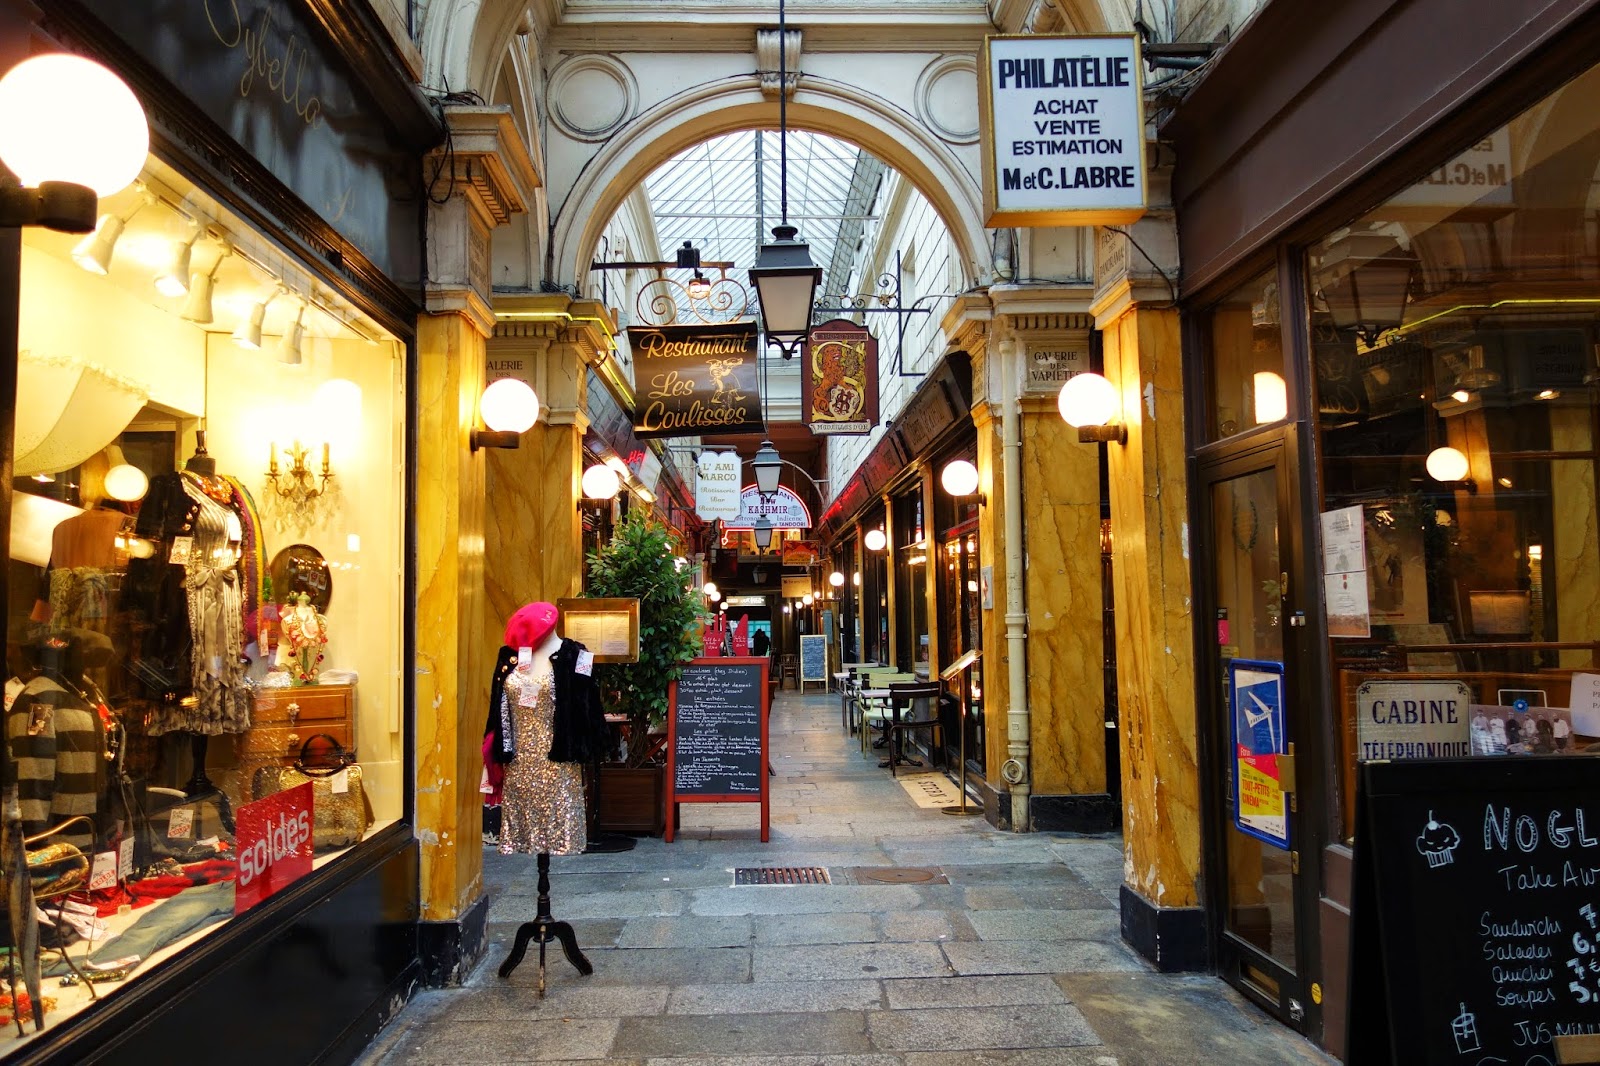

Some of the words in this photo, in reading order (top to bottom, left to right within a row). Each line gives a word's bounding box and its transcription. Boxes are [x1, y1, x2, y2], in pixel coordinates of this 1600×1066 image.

[1033, 99, 1099, 115] ACHAT
[1034, 120, 1100, 135] VENTE
[1012, 139, 1123, 155] ESTIMATION
[640, 332, 749, 358] Restaurant
[487, 361, 523, 370] ALERIE
[648, 371, 695, 399] Les
[643, 400, 747, 431] Coulisses
[715, 463, 735, 471] AMI
[701, 473, 737, 481] MARCO
[742, 489, 795, 502] RESANT
[748, 505, 788, 514] KASHMIR
[1372, 700, 1458, 724] CABINE
[1242, 779, 1271, 797] TOUT-PETITS
[240, 809, 310, 887] soldes
[1498, 860, 1558, 891] Take
[1496, 987, 1556, 1009] Soupes
[1513, 1020, 1552, 1047] JUS
